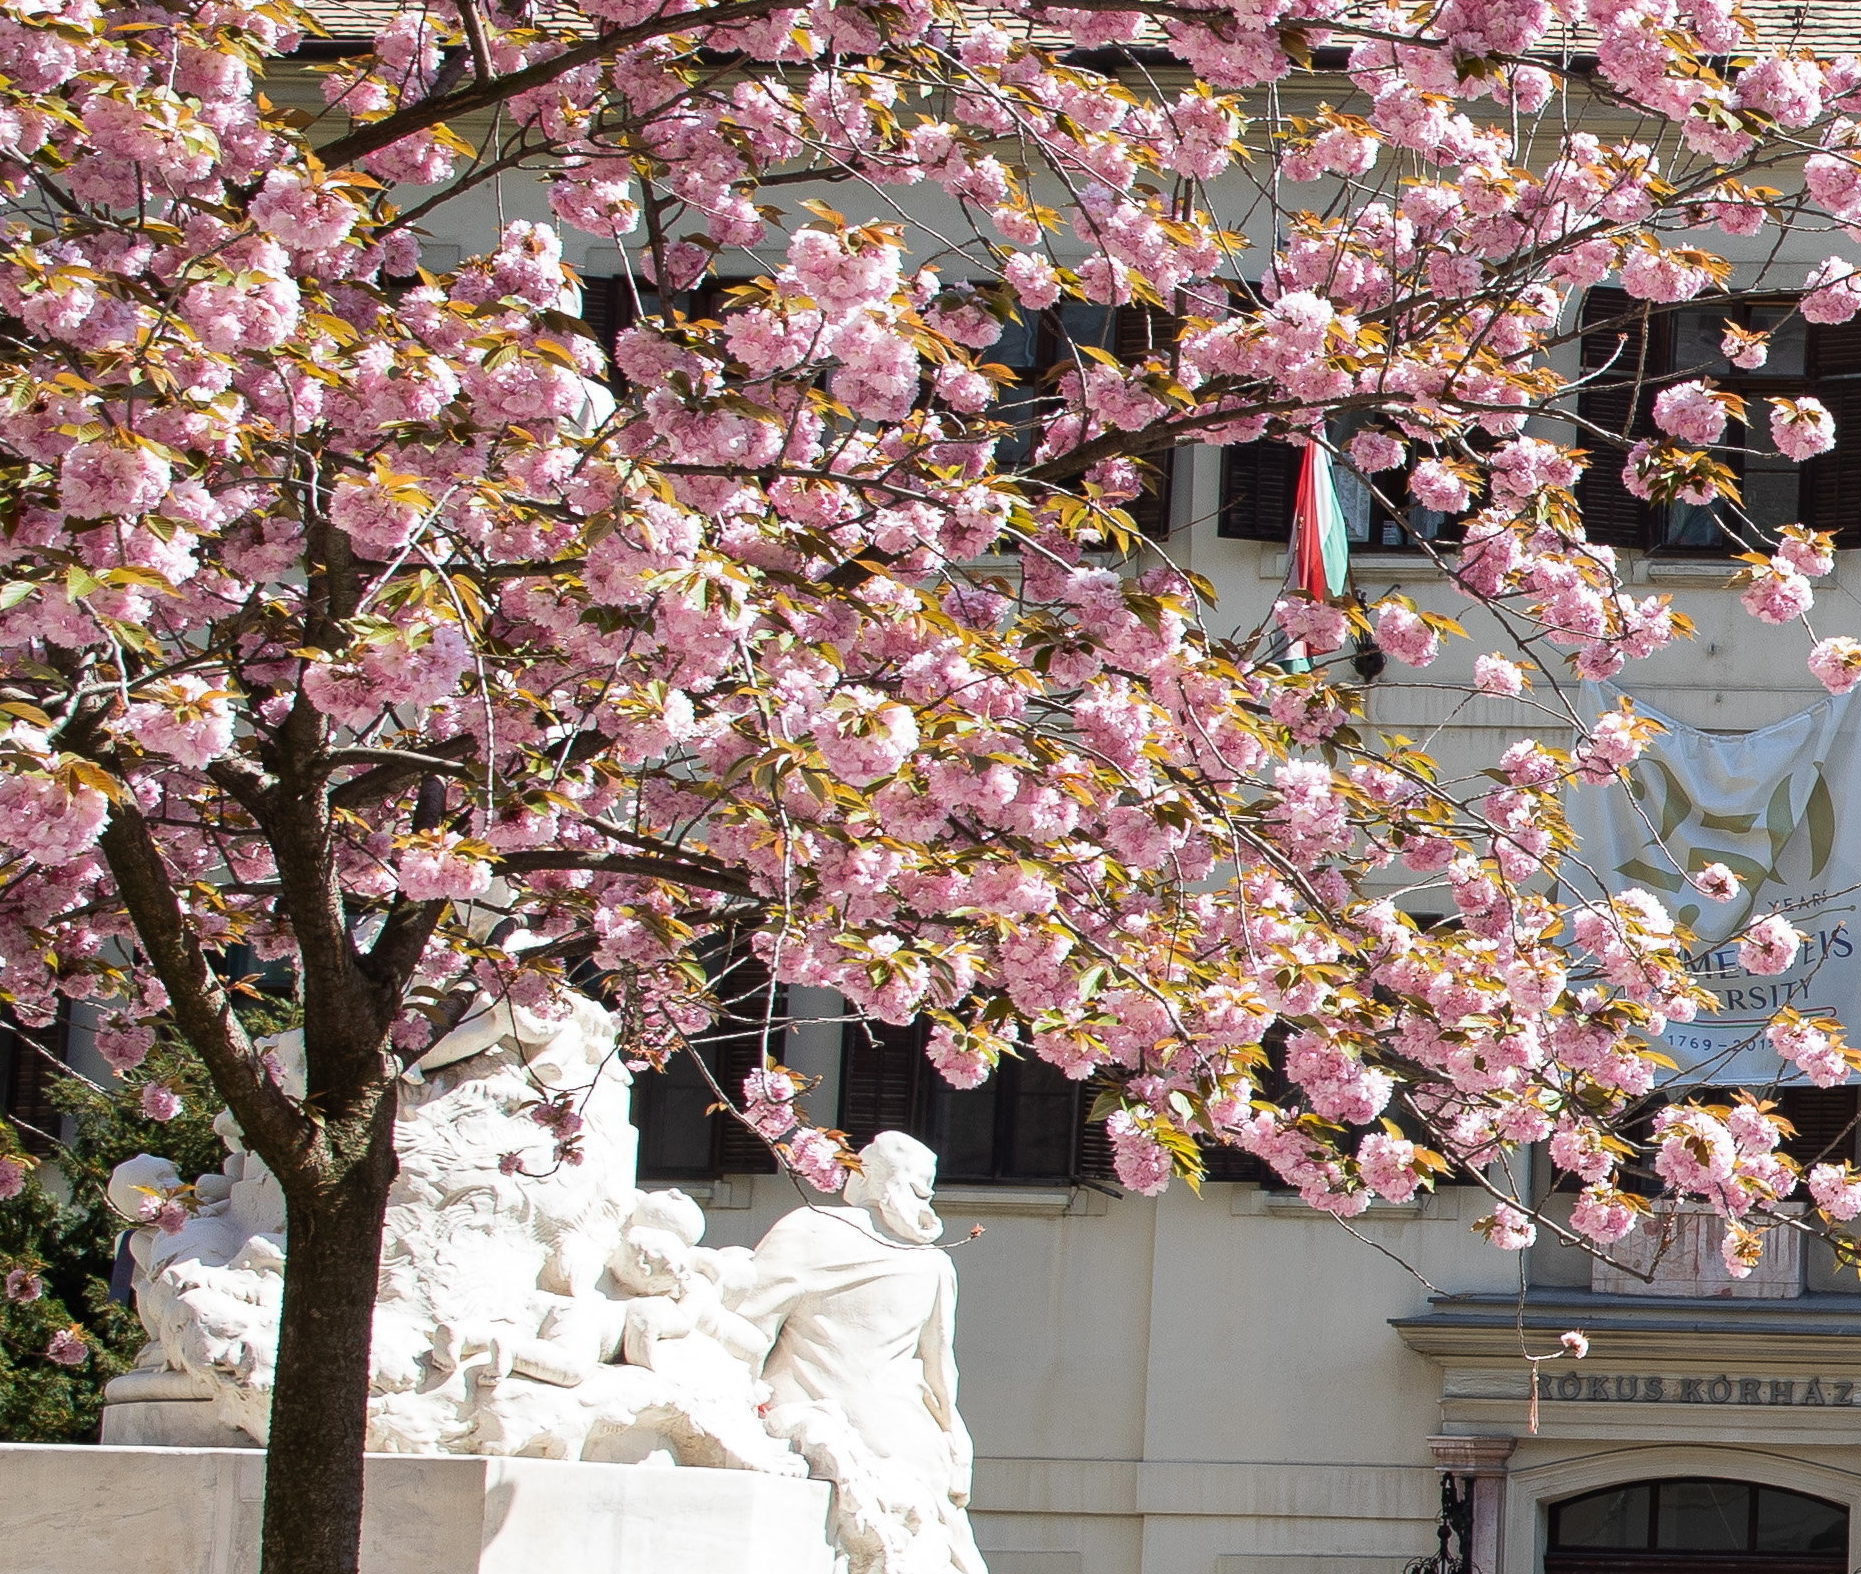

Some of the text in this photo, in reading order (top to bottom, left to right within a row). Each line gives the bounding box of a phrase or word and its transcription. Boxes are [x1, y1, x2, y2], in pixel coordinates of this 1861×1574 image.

[1768, 889, 1827, 911] YEARS
[1538, 1371, 1854, 1405] RÓKUS KÓRHÁZ
